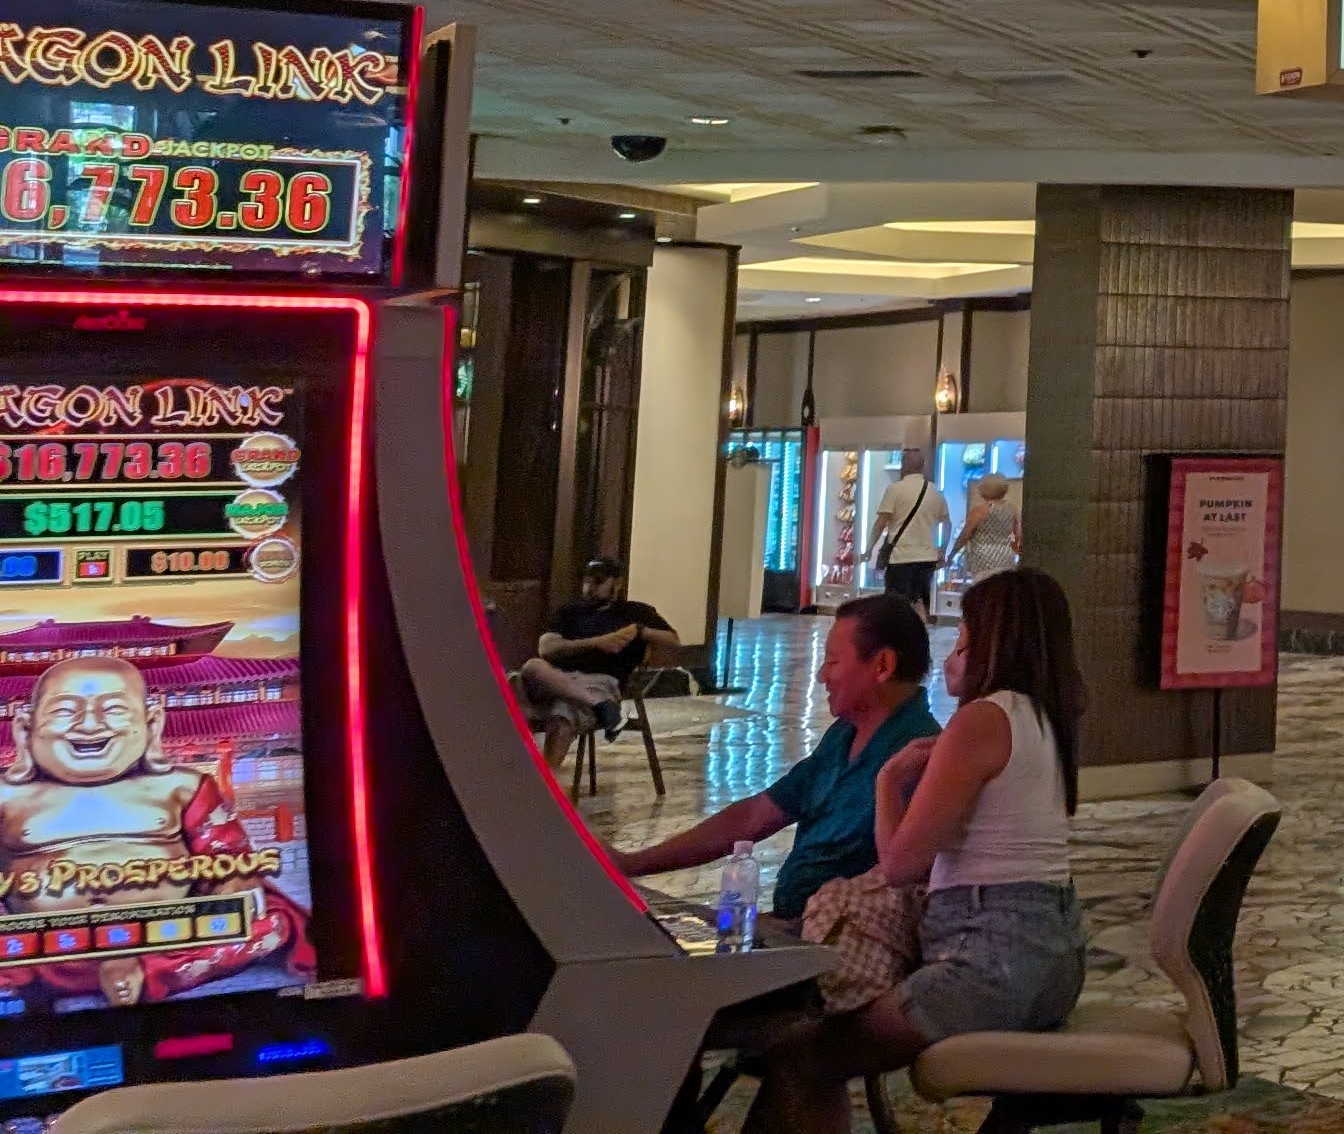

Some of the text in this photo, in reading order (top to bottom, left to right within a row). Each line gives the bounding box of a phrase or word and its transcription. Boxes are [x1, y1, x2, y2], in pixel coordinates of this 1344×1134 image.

[203, 39, 387, 104] LINK
[160, 137, 275, 161] JACKPOT
[151, 385, 284, 426] LINK
[24, 500, 165, 536] $517.05
[1199, 499, 1253, 509] PUMPKIN
[1203, 512, 1247, 523] AT LAST
[151, 550, 231, 574] $10.00
[47, 848, 281, 893] PROSPEROUS
